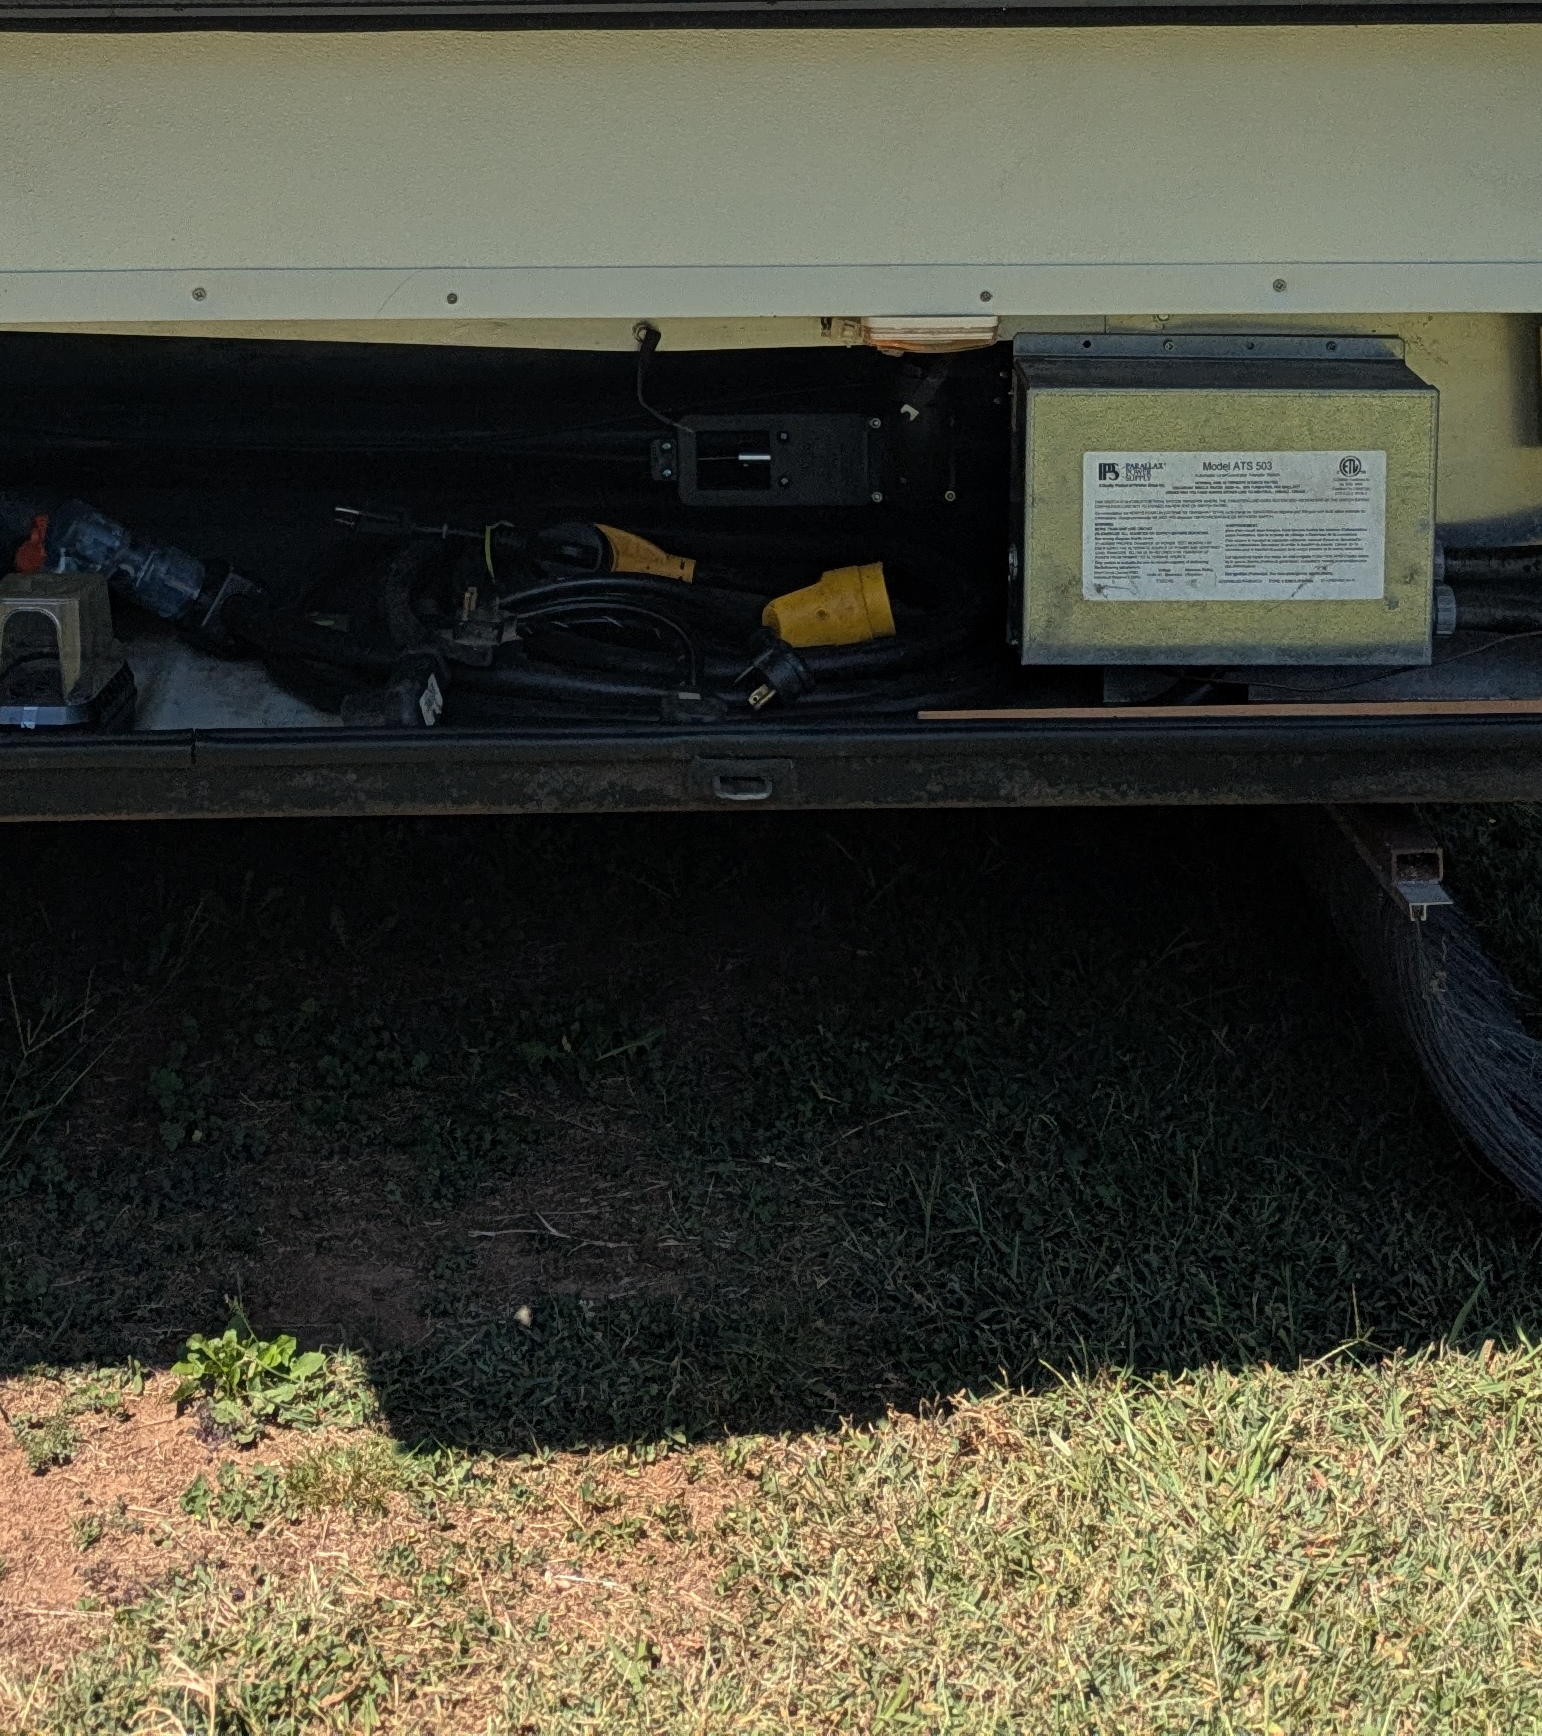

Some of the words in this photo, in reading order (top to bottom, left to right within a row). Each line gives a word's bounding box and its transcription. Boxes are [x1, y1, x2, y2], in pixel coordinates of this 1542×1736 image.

[1125, 462, 1164, 470] PARALLAX
[1202, 460, 1231, 473] Model
[1232, 460, 1254, 472] ATS
[1255, 460, 1273, 472] 503
